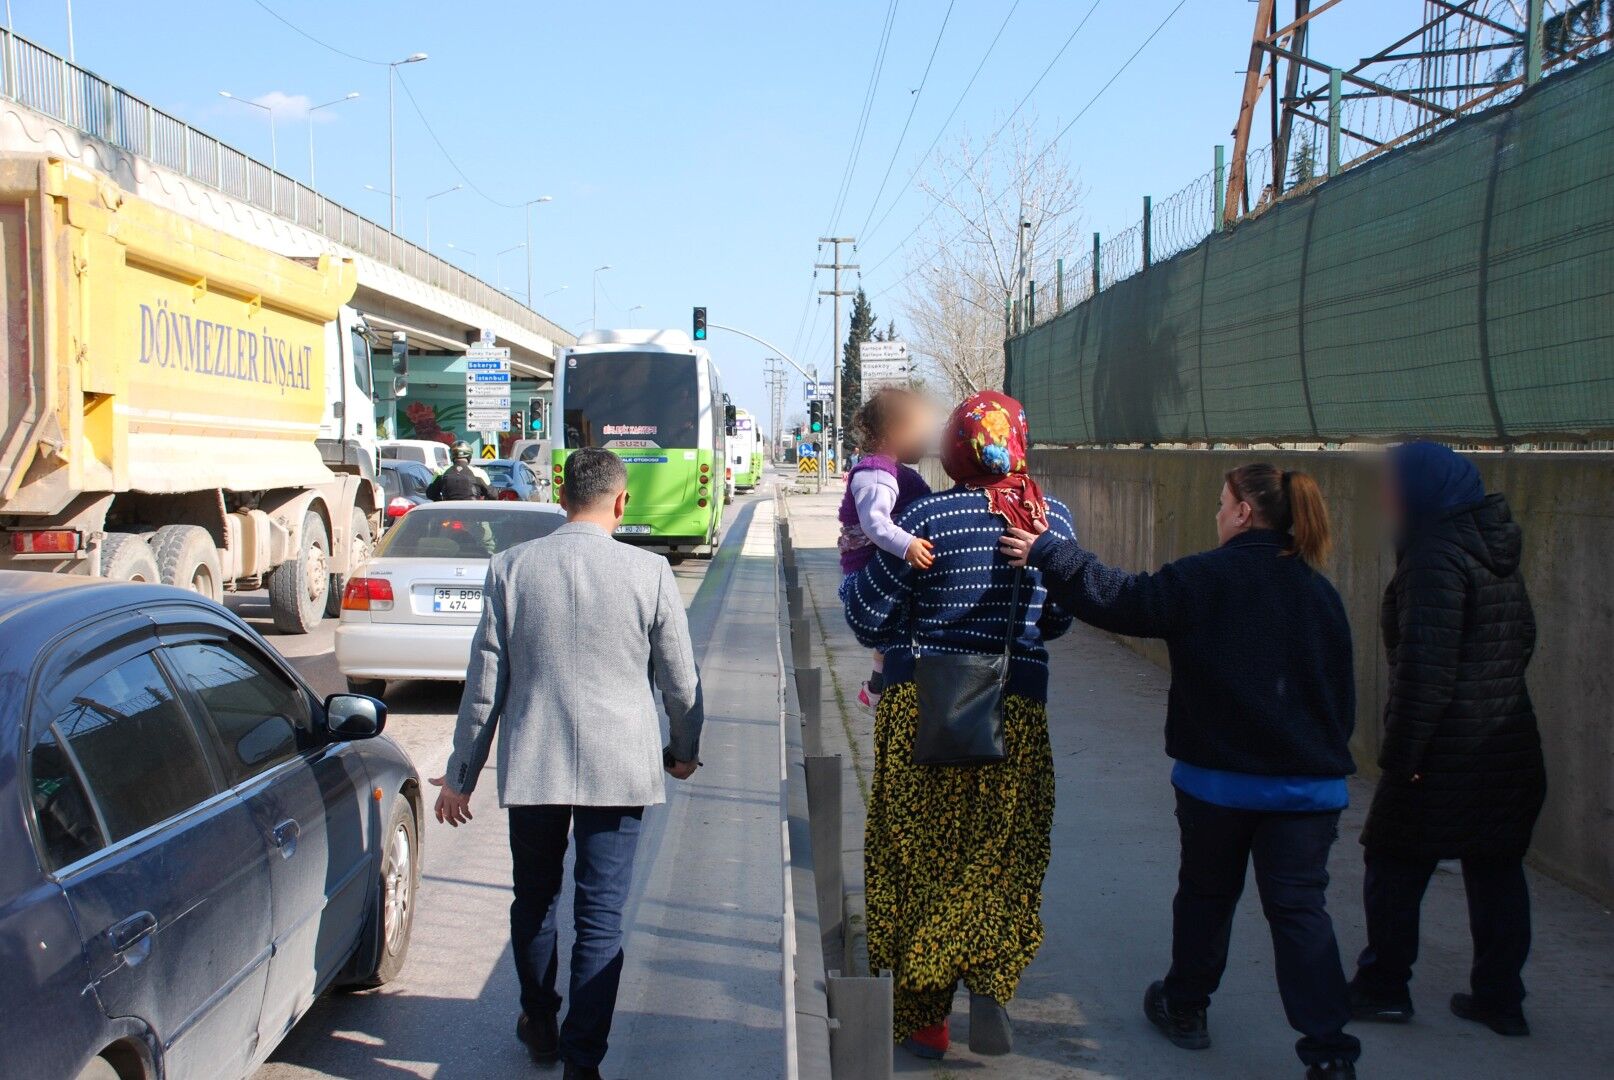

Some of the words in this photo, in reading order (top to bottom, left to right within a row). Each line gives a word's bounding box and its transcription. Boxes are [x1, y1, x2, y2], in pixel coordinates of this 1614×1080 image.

[139, 299, 259, 383] DÖNMEZLER
[262, 326, 312, 395] İNŞAAT
[438, 590, 451, 600] 35
[460, 590, 481, 600] BDG
[449, 601, 467, 610] 474
